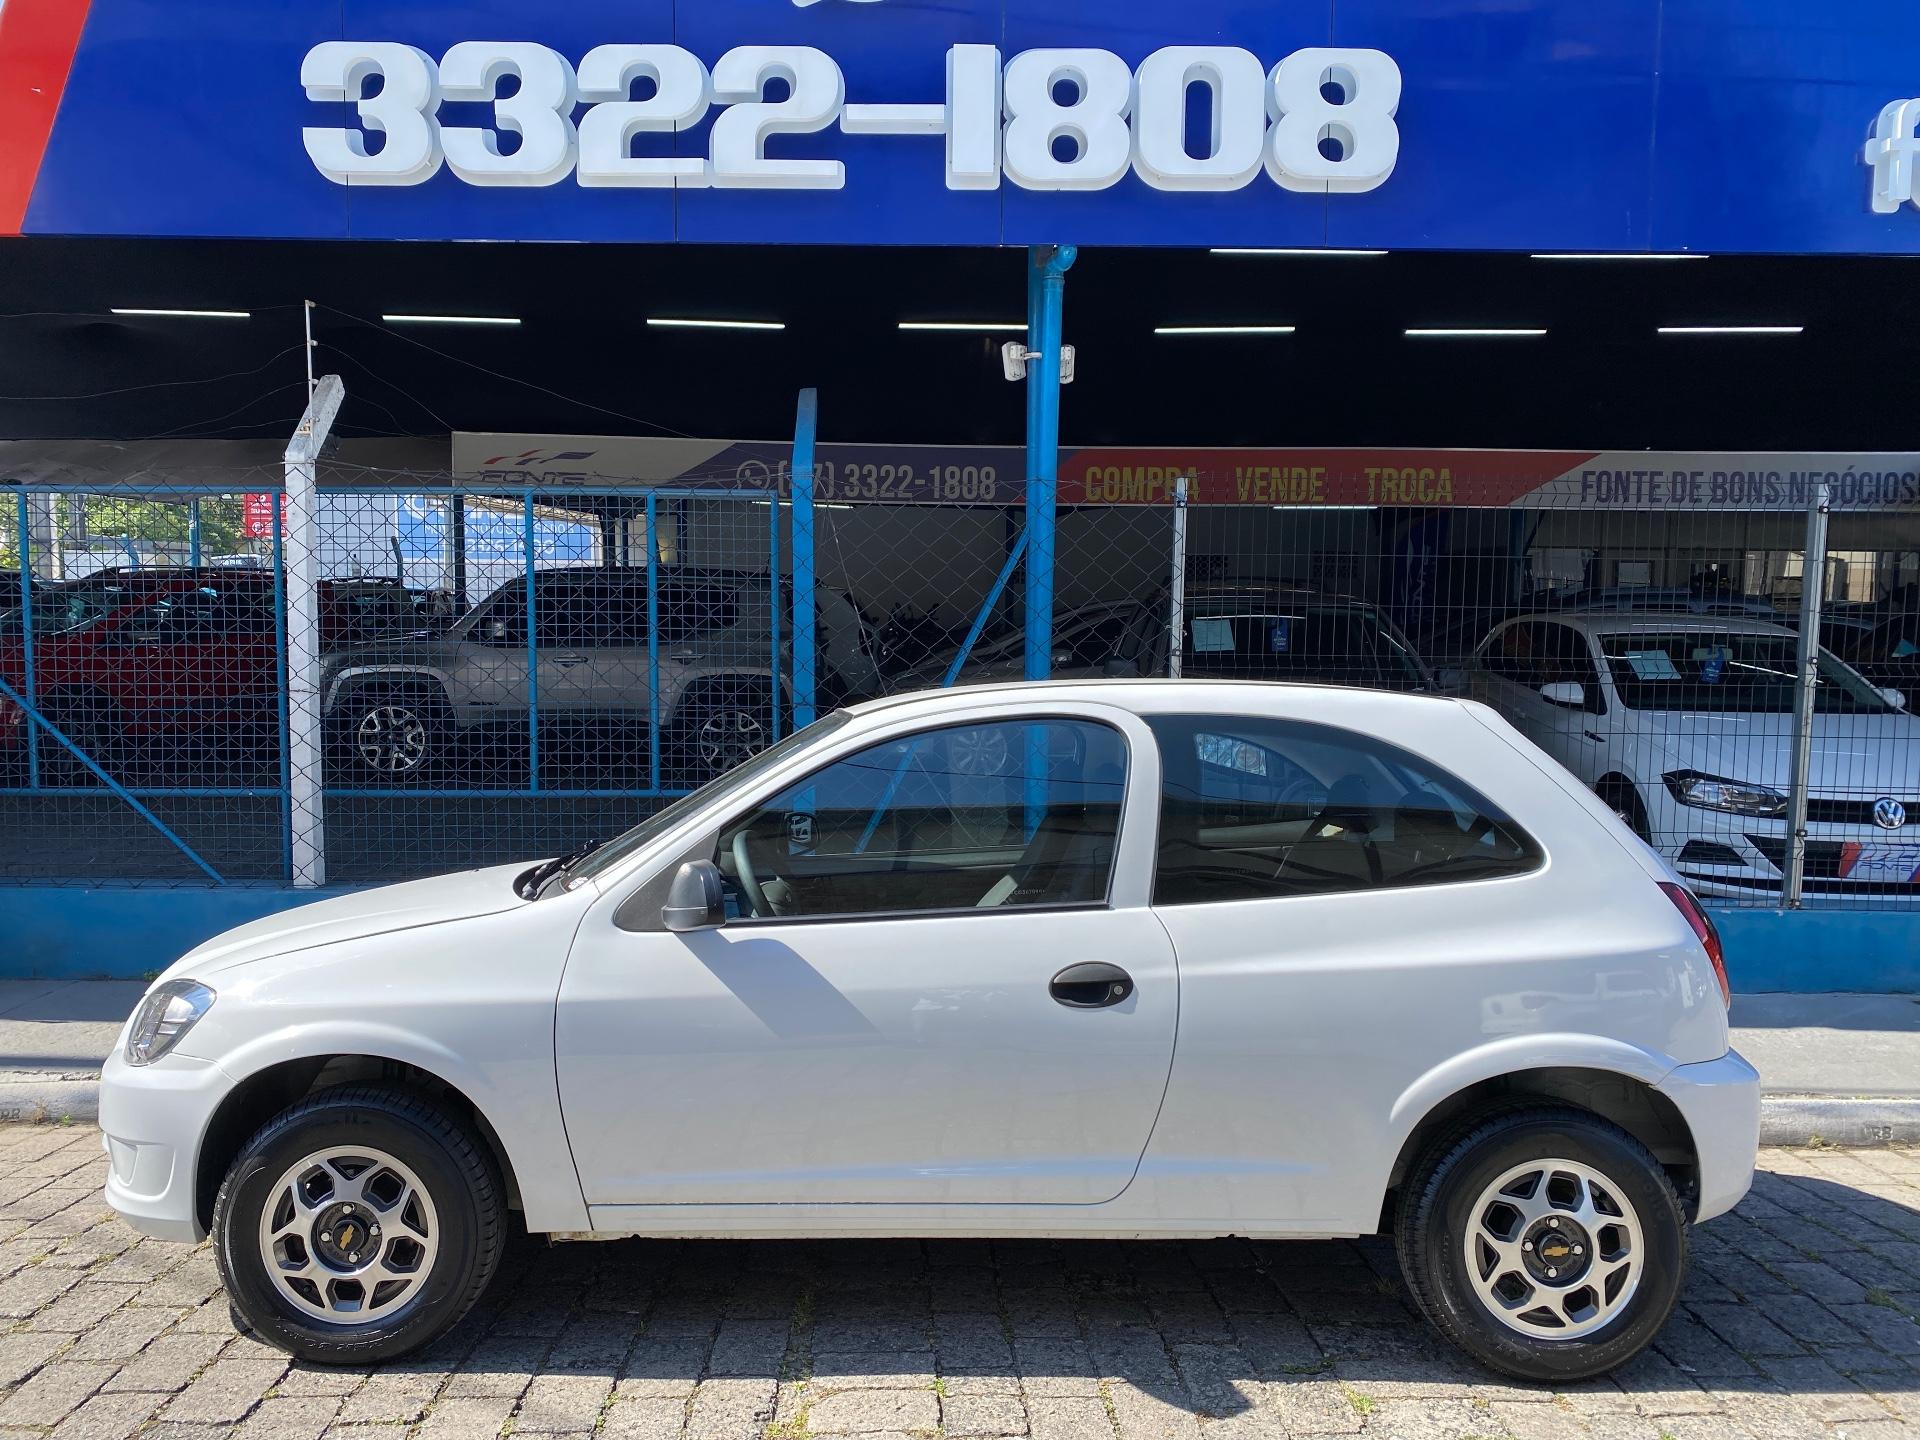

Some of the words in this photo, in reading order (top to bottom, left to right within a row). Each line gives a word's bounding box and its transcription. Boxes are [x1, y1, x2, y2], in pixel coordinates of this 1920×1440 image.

[301, 41, 1402, 193] 3322-1808
[777, 460, 834, 498] (7)
[844, 463, 996, 500] 3322-1808
[1085, 466, 1199, 501] COMPRA
[1235, 467, 1326, 501] VENDE
[1364, 467, 1453, 502] TROCA
[1581, 470, 1664, 503] FONTE
[1670, 471, 1704, 503] DE
[1711, 471, 1780, 504] BONS
[533, 523, 575, 534] SADOS
